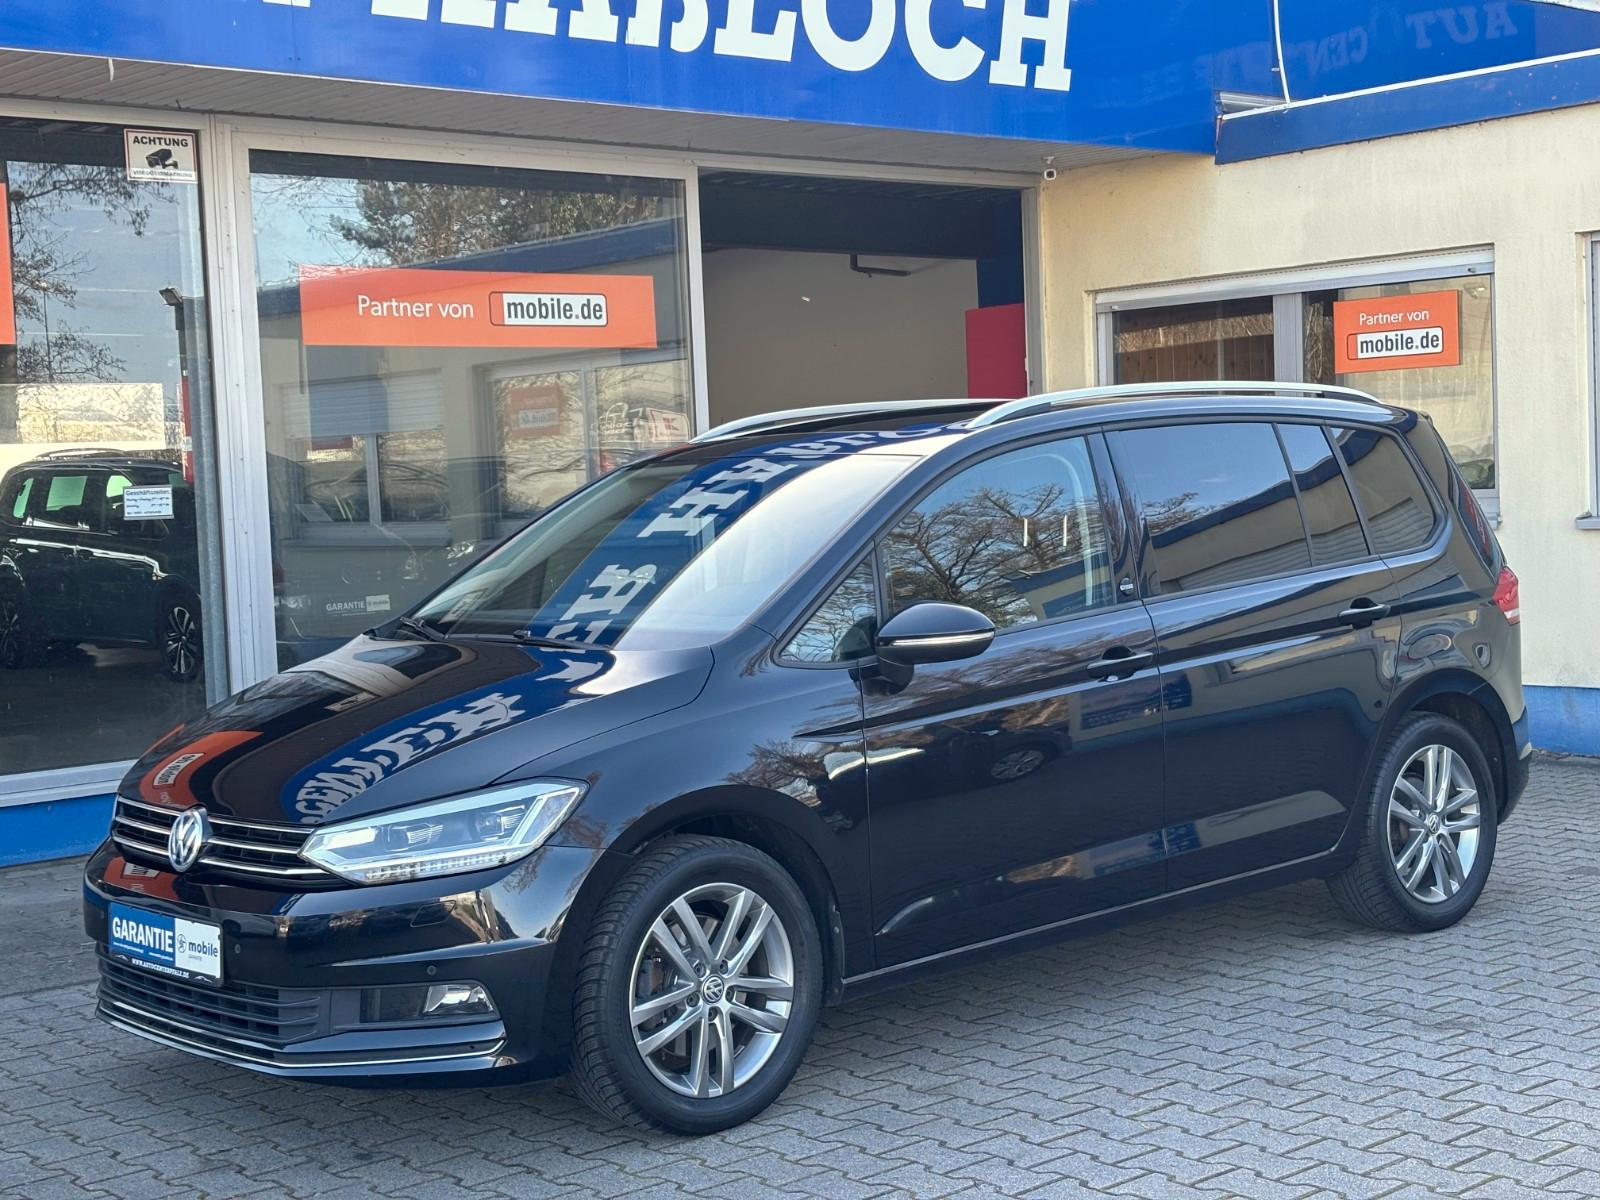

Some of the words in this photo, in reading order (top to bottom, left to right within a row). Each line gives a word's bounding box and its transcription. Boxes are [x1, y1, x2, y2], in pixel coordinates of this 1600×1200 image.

[133, 135, 189, 147] ACHTUNG
[357, 295, 433, 318] Partner
[438, 302, 474, 318] von
[506, 297, 604, 321] mobile.de
[1359, 312, 1404, 326] Partner
[1406, 310, 1430, 321] von
[1360, 331, 1440, 354] mobile.de
[326, 600, 366, 611] GARANTIE
[112, 916, 174, 953] GARANTIE
[188, 940, 219, 958] mobile
